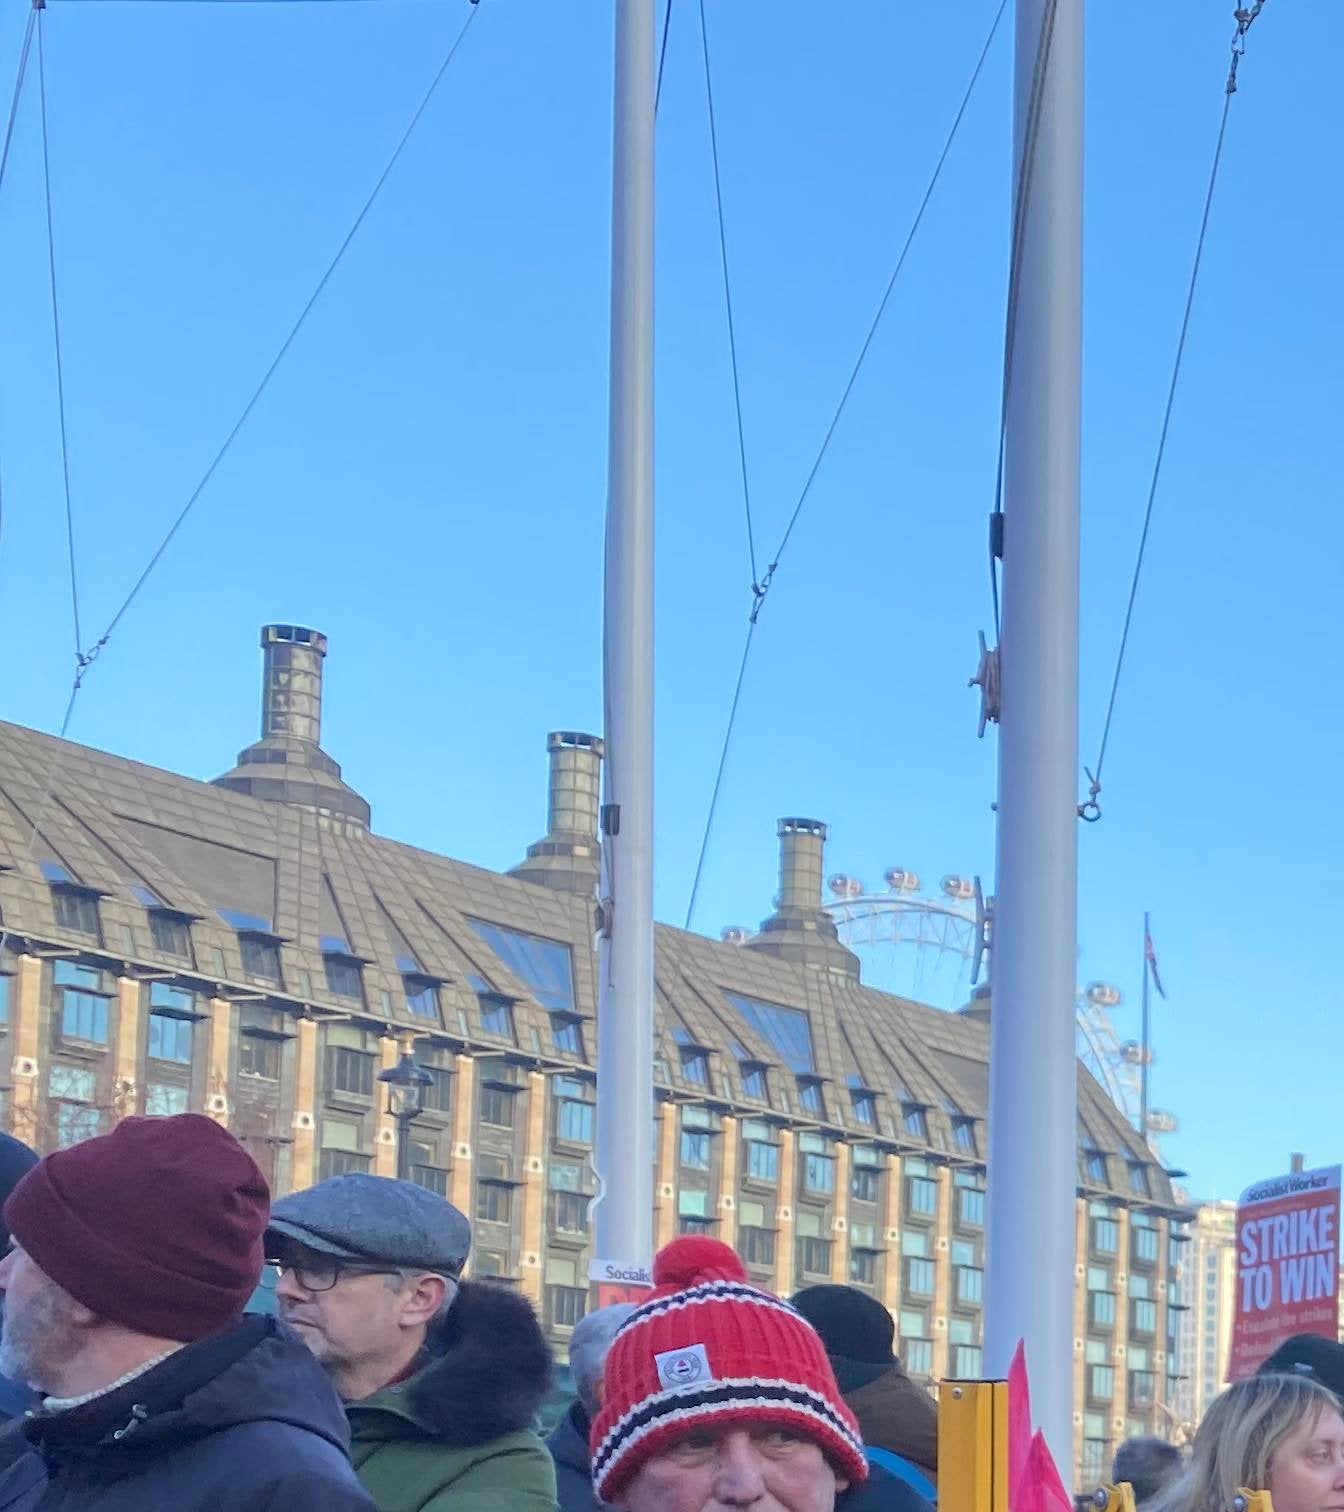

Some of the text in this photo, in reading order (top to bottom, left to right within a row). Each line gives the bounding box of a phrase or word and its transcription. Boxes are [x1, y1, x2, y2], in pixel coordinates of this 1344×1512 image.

[1239, 1203, 1336, 1266] STRIKE
[1240, 1252, 1335, 1313] TO WIN
